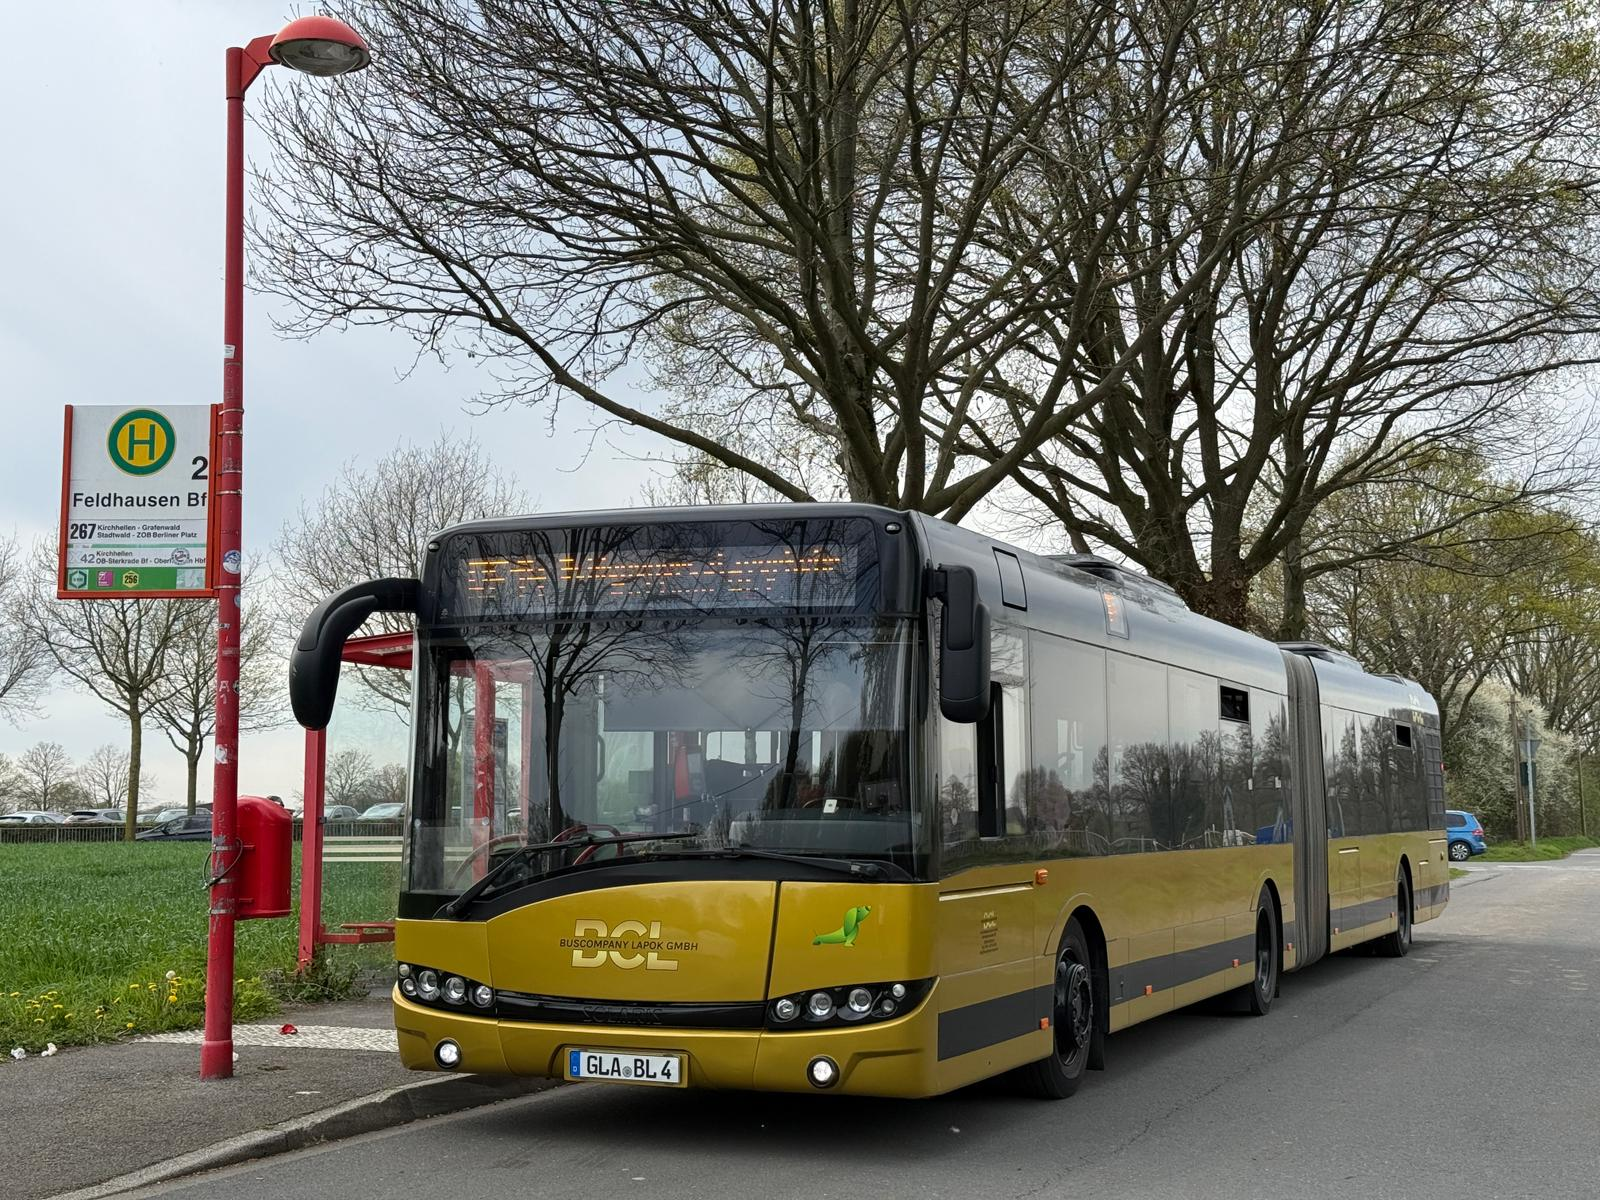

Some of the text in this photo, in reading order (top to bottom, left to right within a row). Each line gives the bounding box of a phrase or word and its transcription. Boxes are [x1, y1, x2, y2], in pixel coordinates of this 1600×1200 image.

[127, 424, 156, 461] H
[191, 455, 208, 480] 2
[73, 491, 208, 508] Feldhausen Bf
[69, 523, 97, 540] 267
[124, 574, 138, 584] 256
[559, 938, 699, 952] BUSCOMPANY LAPOK GMBH
[586, 1054, 672, 1081] GLA BL 4
